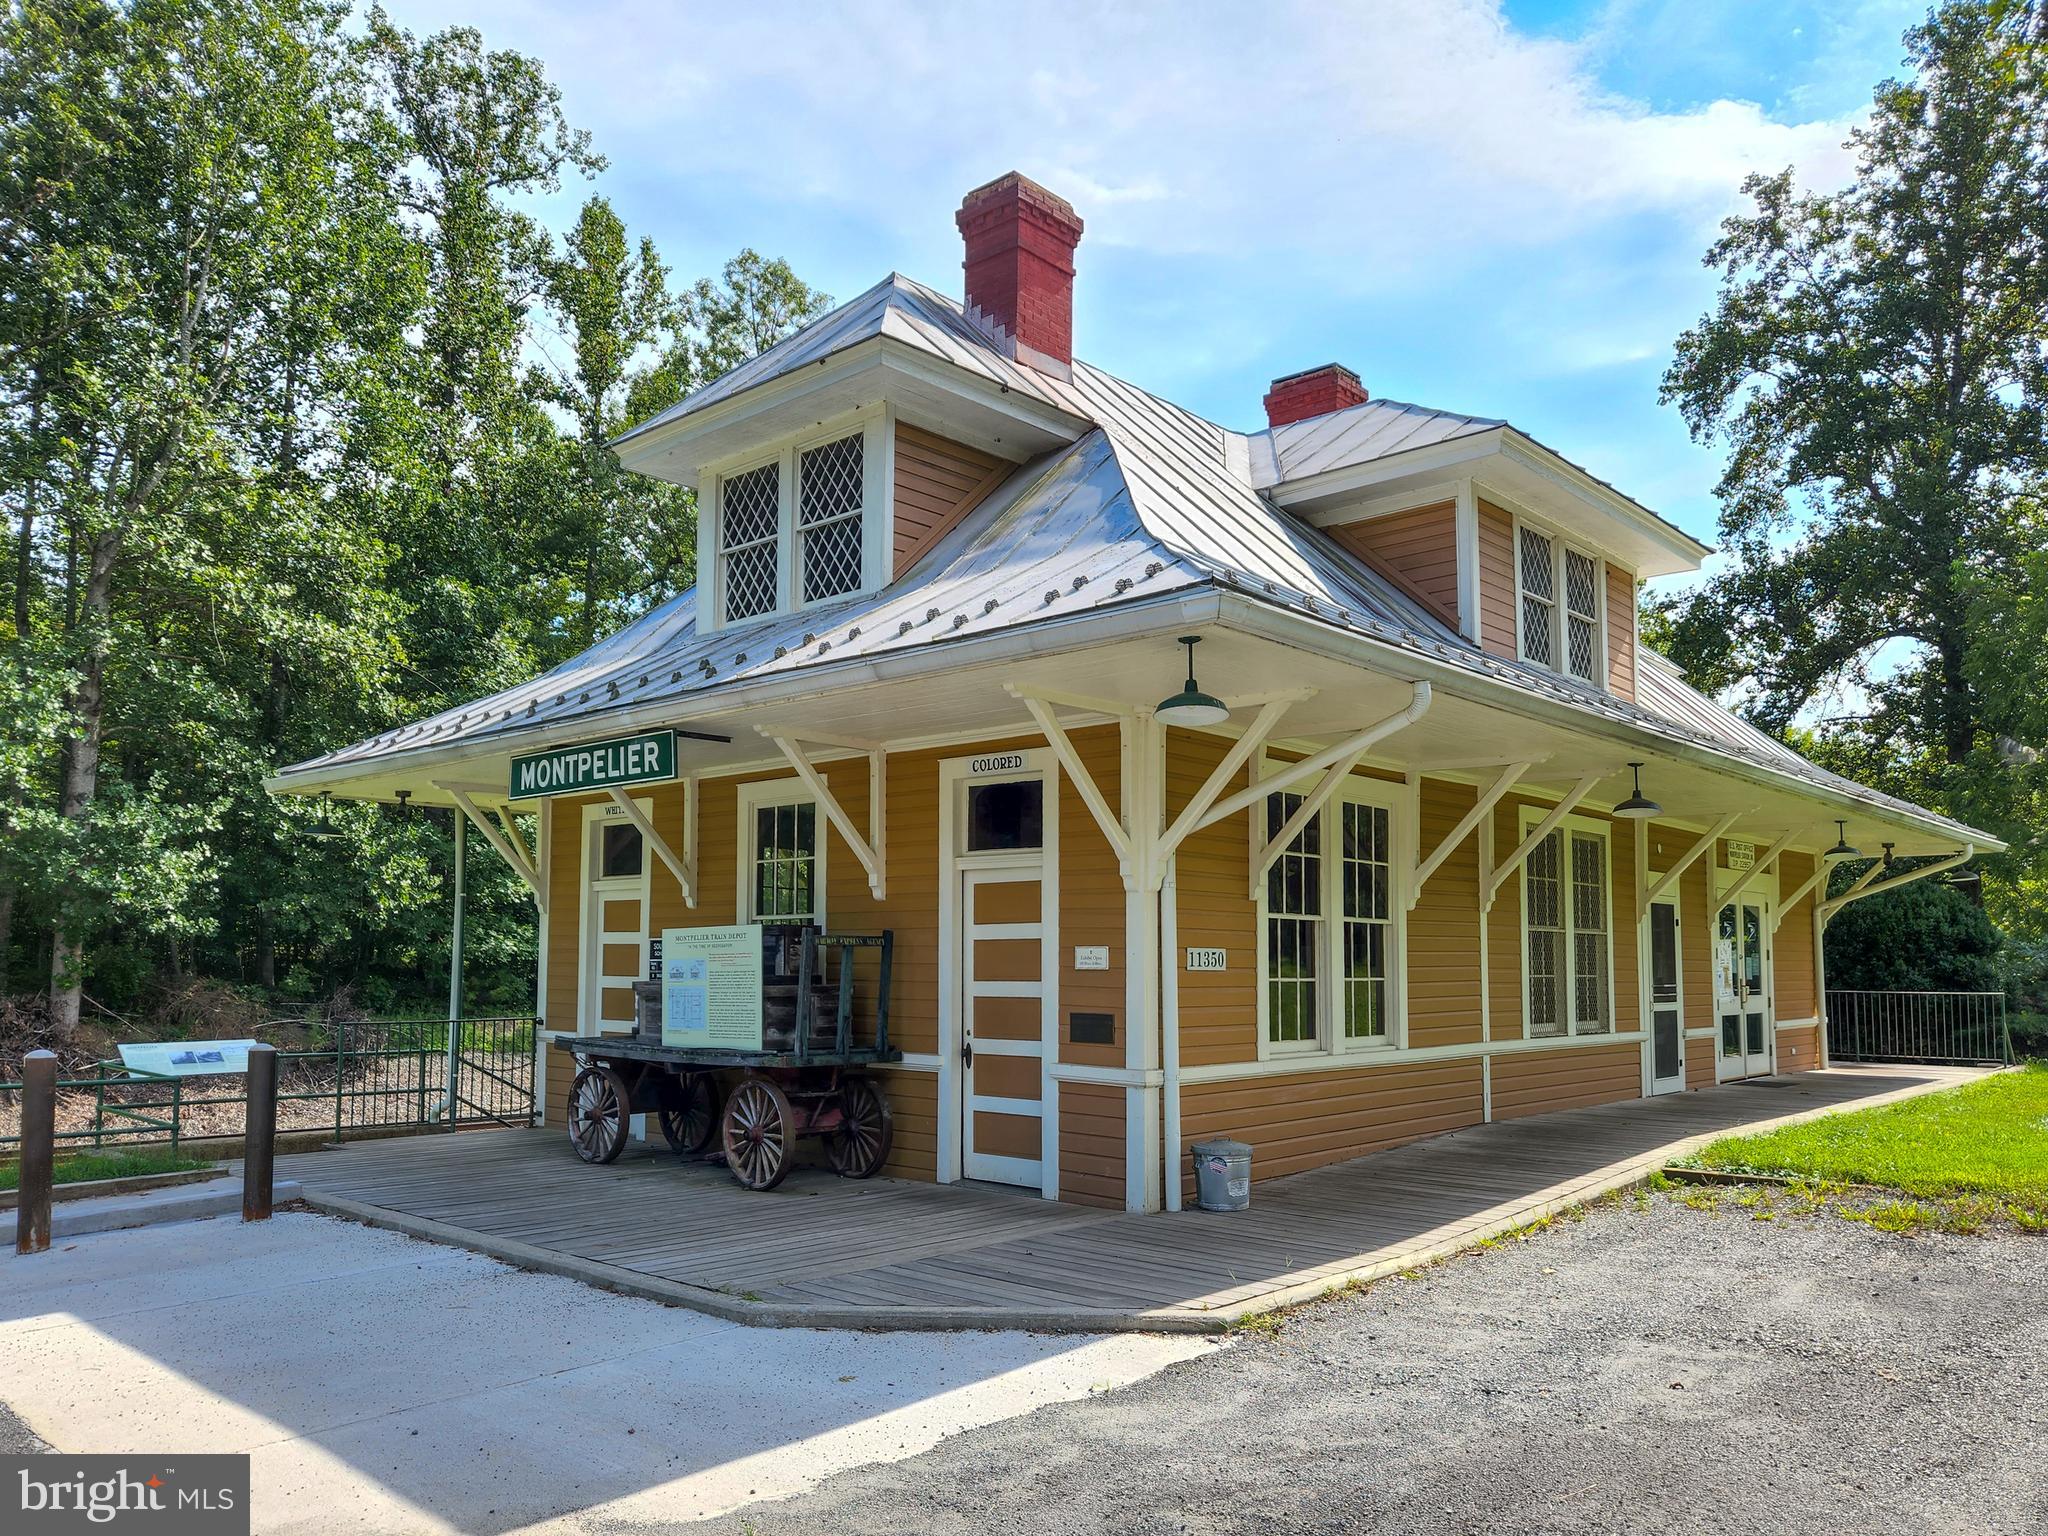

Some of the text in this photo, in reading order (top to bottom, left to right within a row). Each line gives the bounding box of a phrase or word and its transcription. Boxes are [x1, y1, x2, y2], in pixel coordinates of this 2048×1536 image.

[520, 741, 660, 791] MONTPELIER
[972, 755, 1022, 772] COLORED
[604, 805, 625, 816] WHIT
[675, 932, 747, 942] MONTPELIER TRAIN DEPOT
[1189, 951, 1224, 968] 11350
